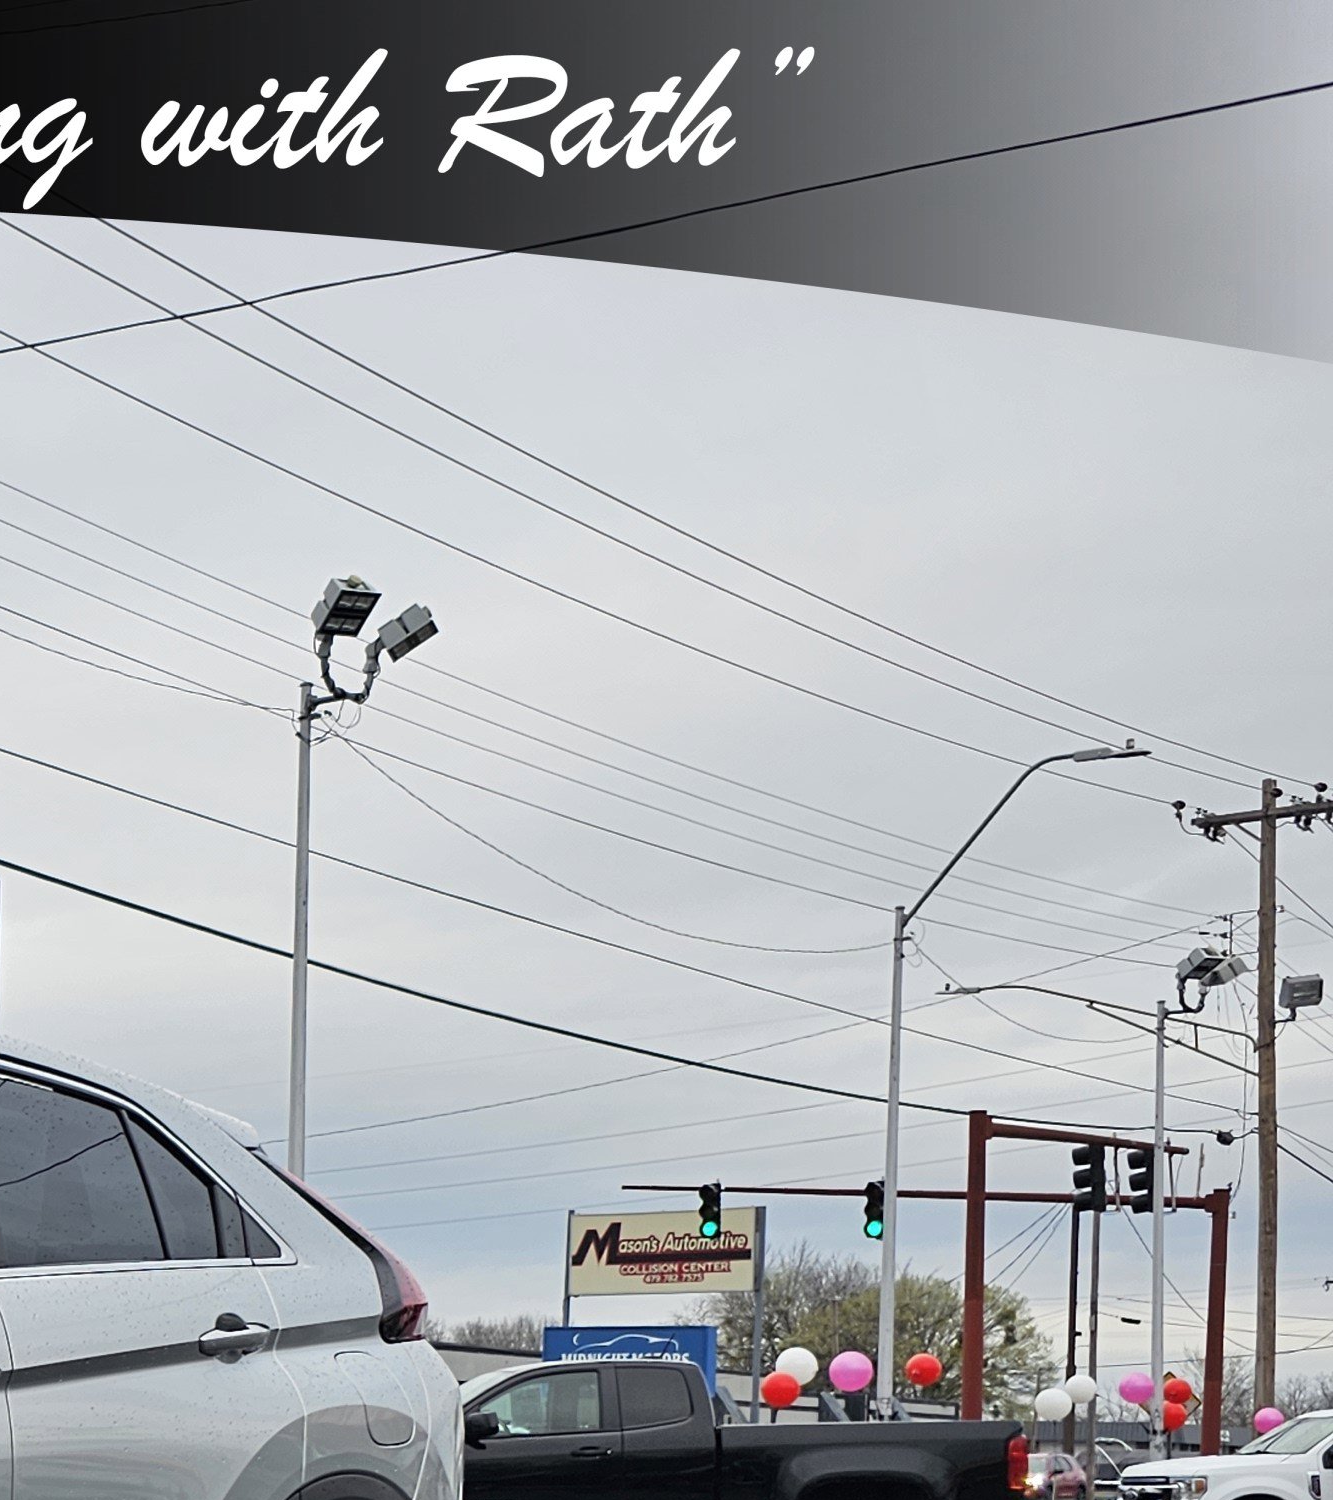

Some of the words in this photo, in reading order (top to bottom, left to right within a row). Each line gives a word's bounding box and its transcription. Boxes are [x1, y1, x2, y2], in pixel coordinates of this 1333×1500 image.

[572, 1222, 659, 1266] Mason's
[662, 1231, 748, 1252] Automotive
[620, 1263, 678, 1275] COLLISION
[682, 1261, 729, 1273] CENTER
